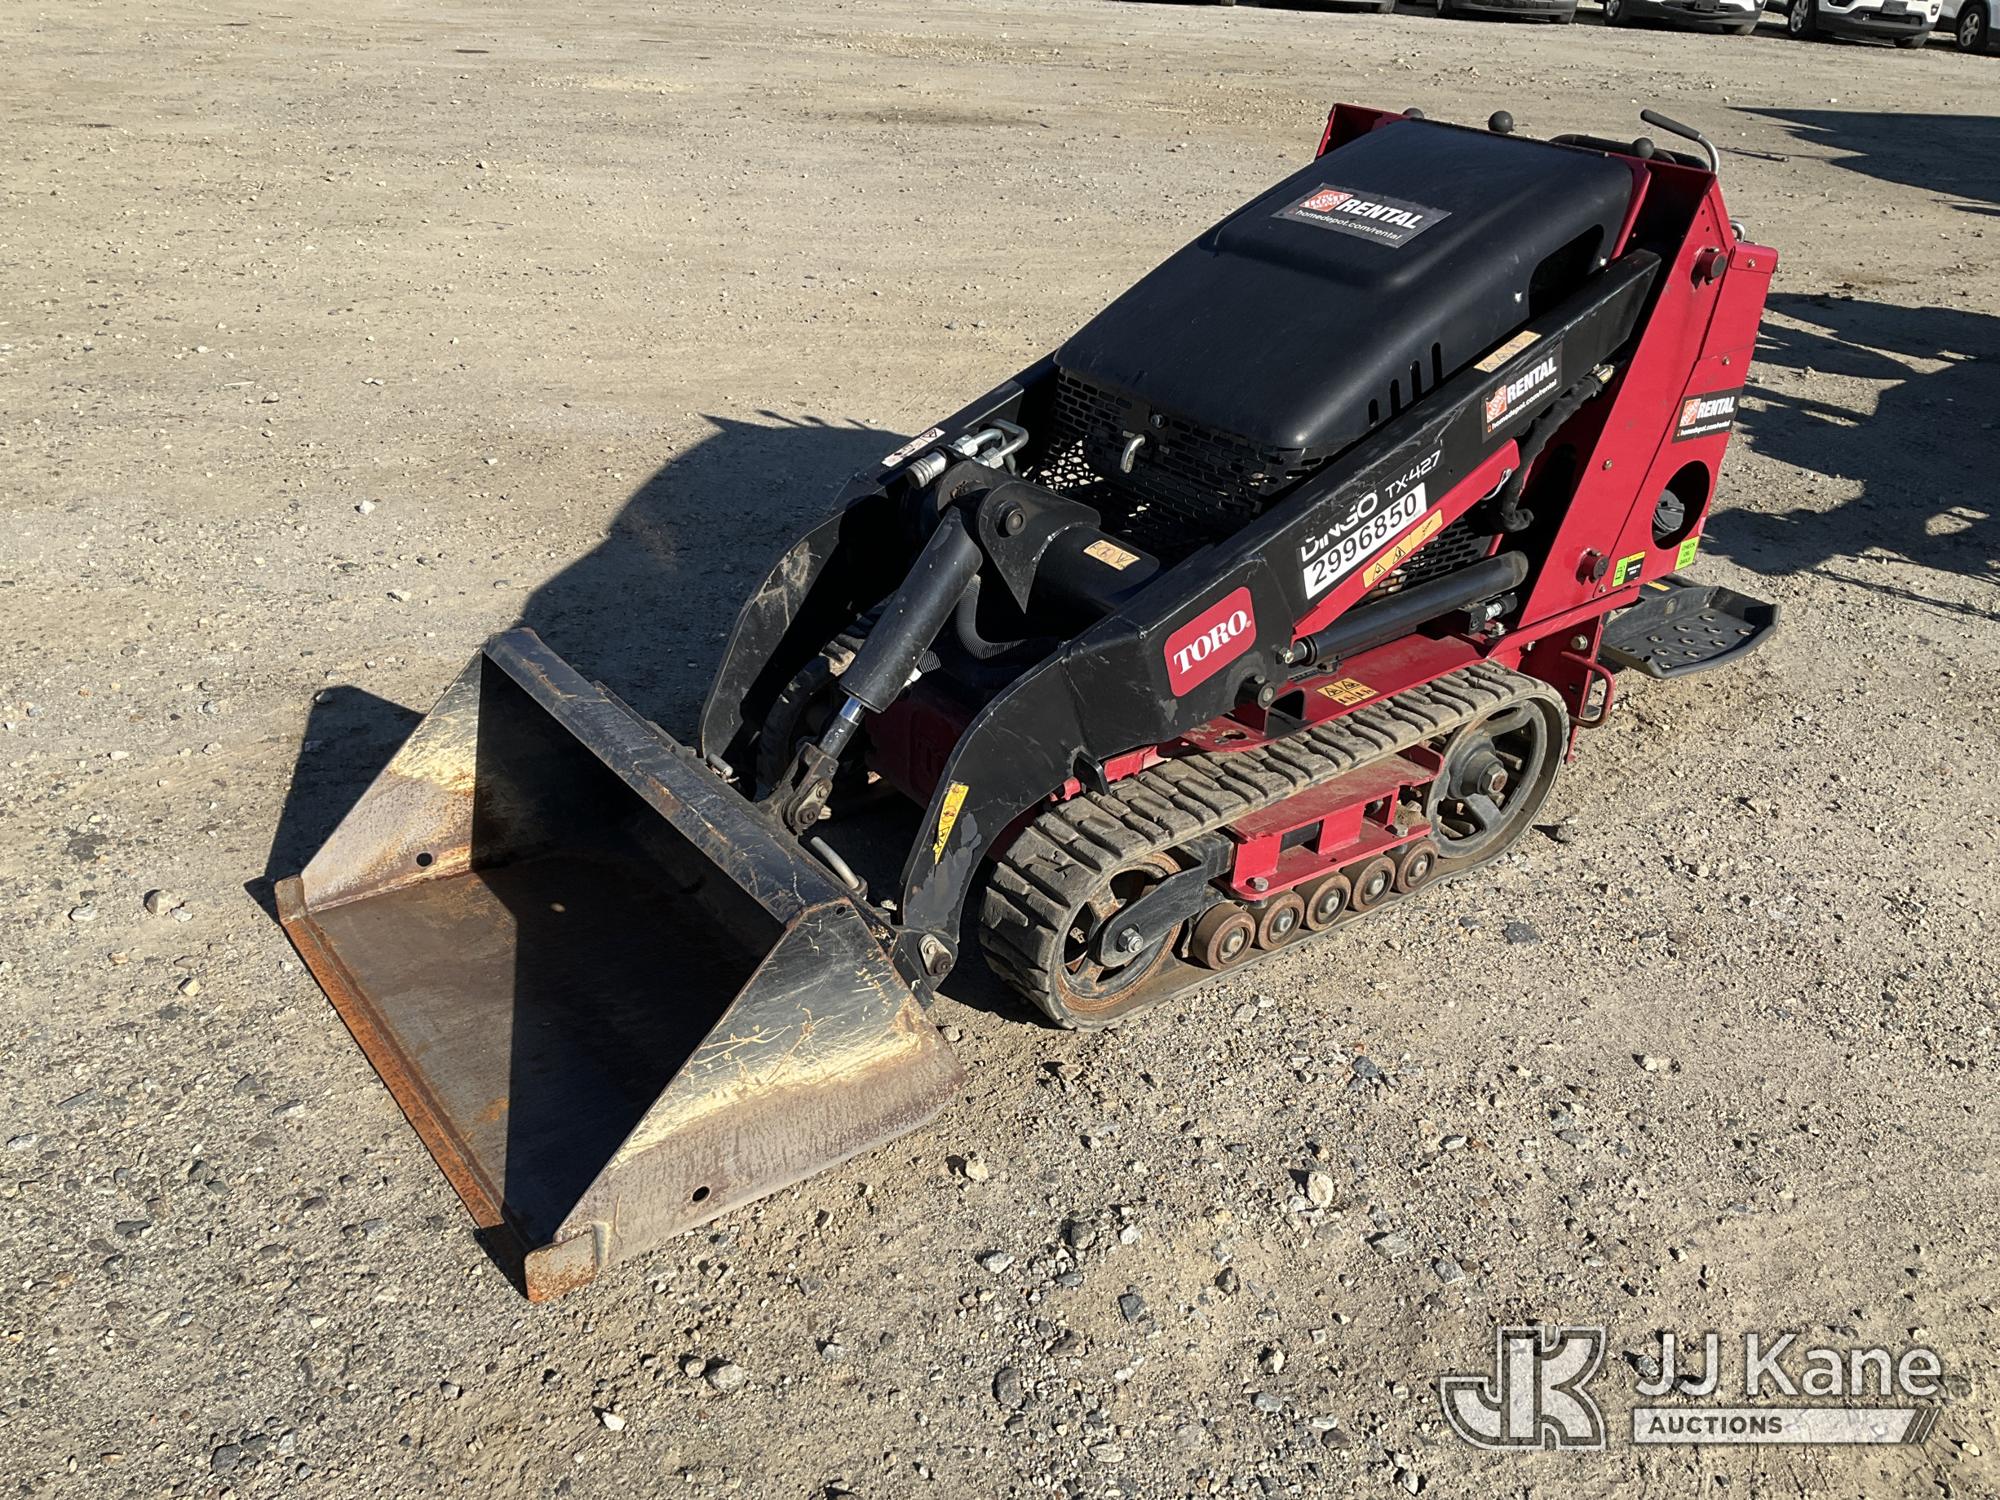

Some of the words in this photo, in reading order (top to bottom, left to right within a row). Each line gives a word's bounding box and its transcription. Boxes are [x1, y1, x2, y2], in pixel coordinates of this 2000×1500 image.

[1295, 209, 1403, 241] homedepot.com/rental
[1336, 198, 1424, 230] RENTAL
[1507, 357, 1557, 404] RENTAL
[1696, 396, 1736, 419] RENTAL
[1300, 491, 1378, 562] DINGO
[1312, 492, 1417, 587] 2996850
